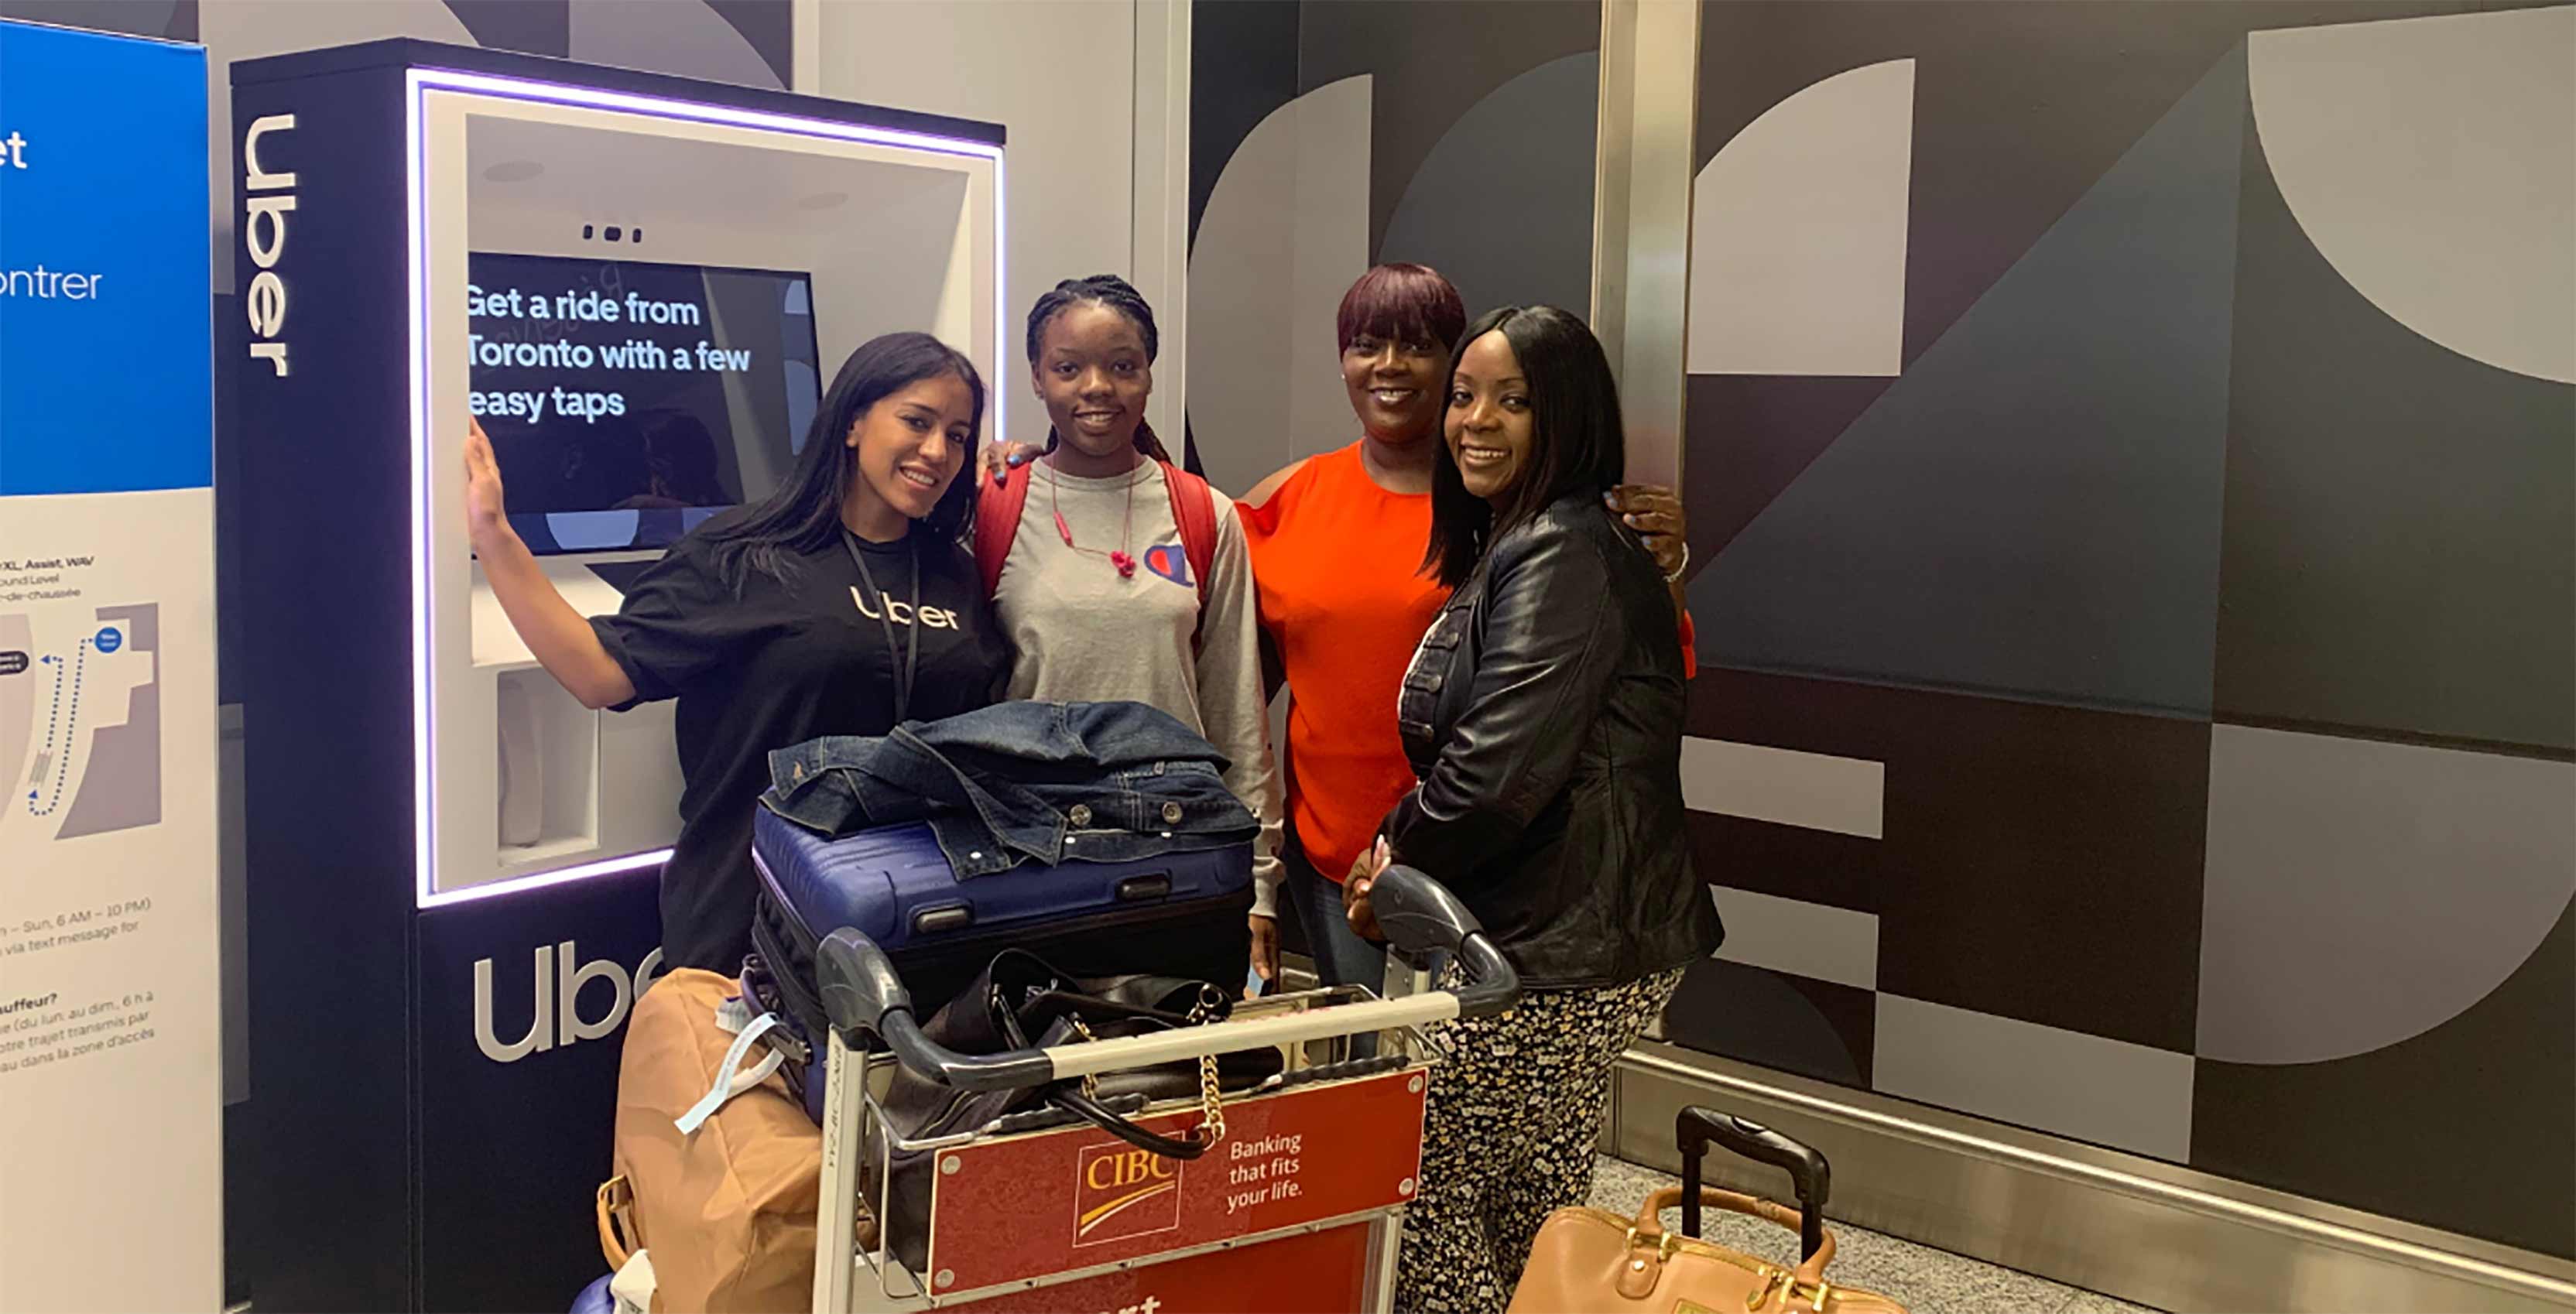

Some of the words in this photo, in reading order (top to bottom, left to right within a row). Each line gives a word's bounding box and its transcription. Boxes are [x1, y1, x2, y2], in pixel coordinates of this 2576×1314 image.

[245, 113, 296, 377] Uber
[0, 264, 103, 300] ntrer
[468, 283, 524, 318] Get
[529, 295, 551, 320] a
[556, 289, 622, 322] ride
[625, 291, 701, 326] from
[468, 334, 594, 368] Toronto
[598, 339, 667, 371] with
[672, 347, 693, 371] a
[695, 340, 752, 372] few
[469, 390, 546, 424] easy
[550, 385, 625, 424] taps
[30, 573, 60, 586] Level
[850, 585, 959, 631] Uber
[57, 914, 66, 927] 6
[69, 909, 91, 923] AM
[107, 904, 122, 918] 10
[124, 896, 151, 913] PM)
[4, 943, 25, 956] via
[29, 936, 54, 951] text
[58, 926, 118, 946] message
[120, 921, 139, 934] for
[13, 1018, 37, 1032] (du
[68, 1008, 85, 1020] au
[122, 994, 131, 1007] 6
[28, 1030, 64, 1048] trajet
[67, 1018, 125, 1038] transmis
[128, 1011, 150, 1028] par
[21, 1052, 54, 1069] dans
[57, 1047, 70, 1060] la
[72, 1041, 104, 1057] zone
[1231, 1133, 1303, 1160] Banking
[1087, 1148, 1174, 1190] CIBC
[1229, 1165, 1266, 1185] that
[1271, 1157, 1300, 1177] fits
[1227, 1186, 1268, 1215] your
[1272, 1179, 1303, 1199] life.
